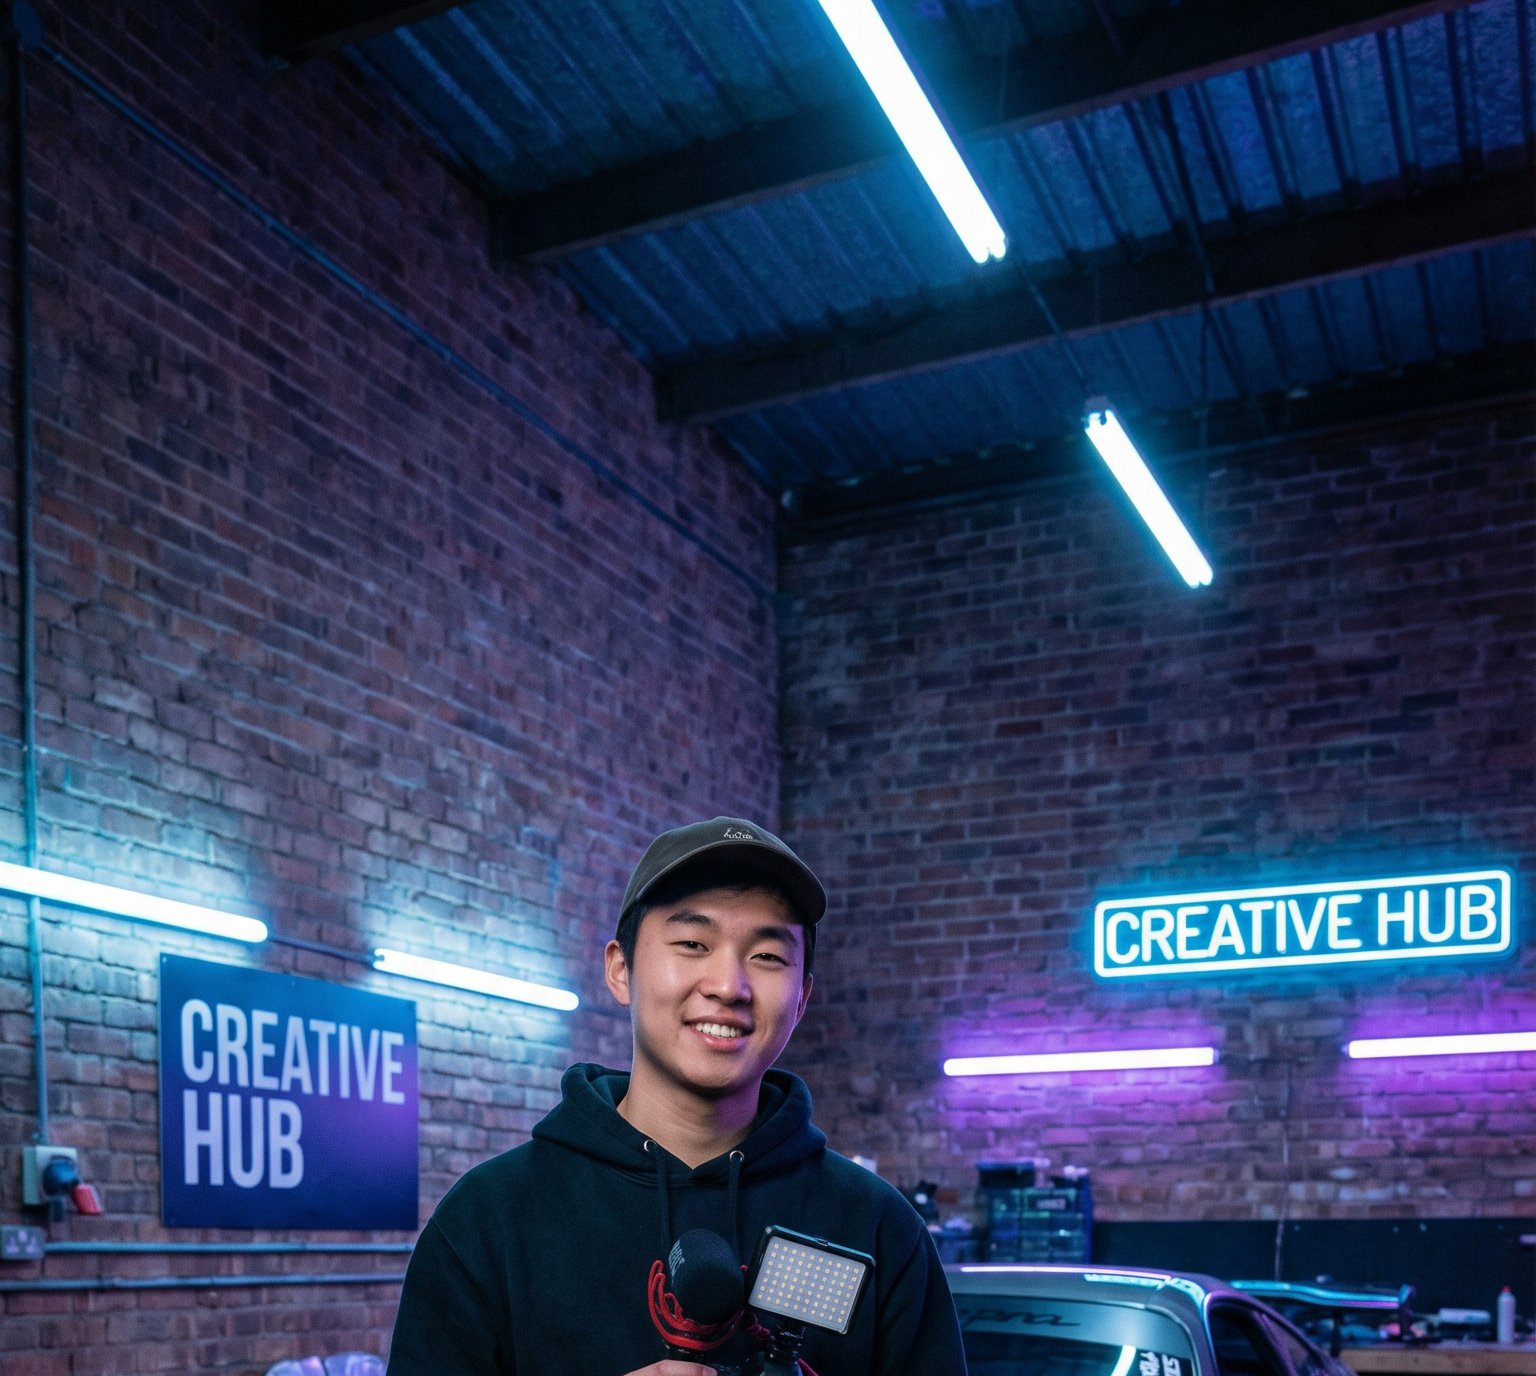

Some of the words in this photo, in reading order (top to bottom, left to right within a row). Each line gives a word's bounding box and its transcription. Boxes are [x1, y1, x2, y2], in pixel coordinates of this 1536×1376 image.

[1106, 894, 1362, 964] CREATIVE
[1378, 885, 1497, 946] HUB
[181, 999, 405, 1105] CREATIVE
[183, 1089, 304, 1188] HUB
